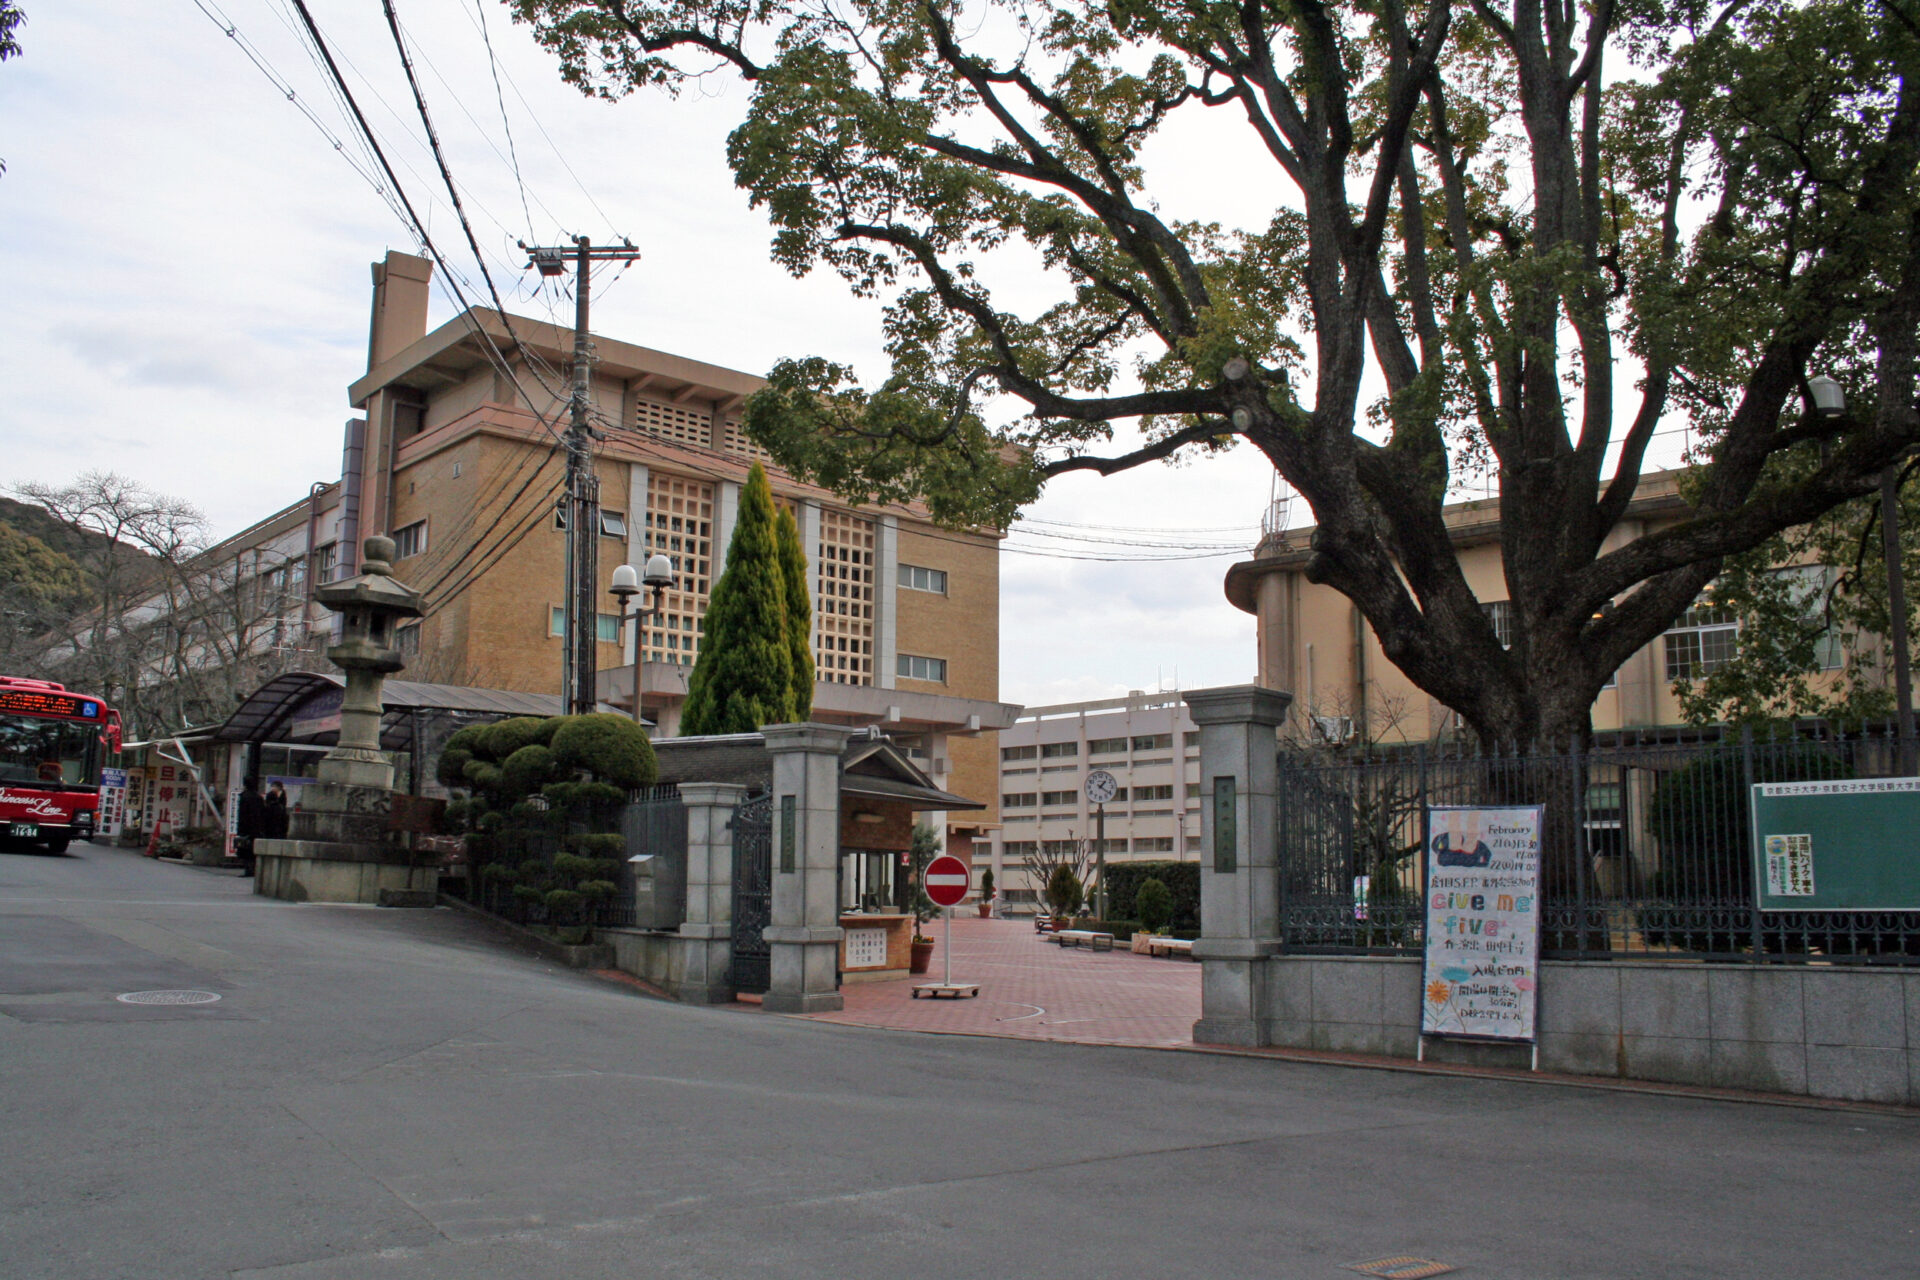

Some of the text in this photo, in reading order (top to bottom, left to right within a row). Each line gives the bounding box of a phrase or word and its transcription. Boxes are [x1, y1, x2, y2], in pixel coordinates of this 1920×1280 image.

[26, 798, 67, 816] Line
[1488, 824, 1531, 835] February
[1497, 894, 1530, 912] me
[1443, 915, 1499, 936] five
